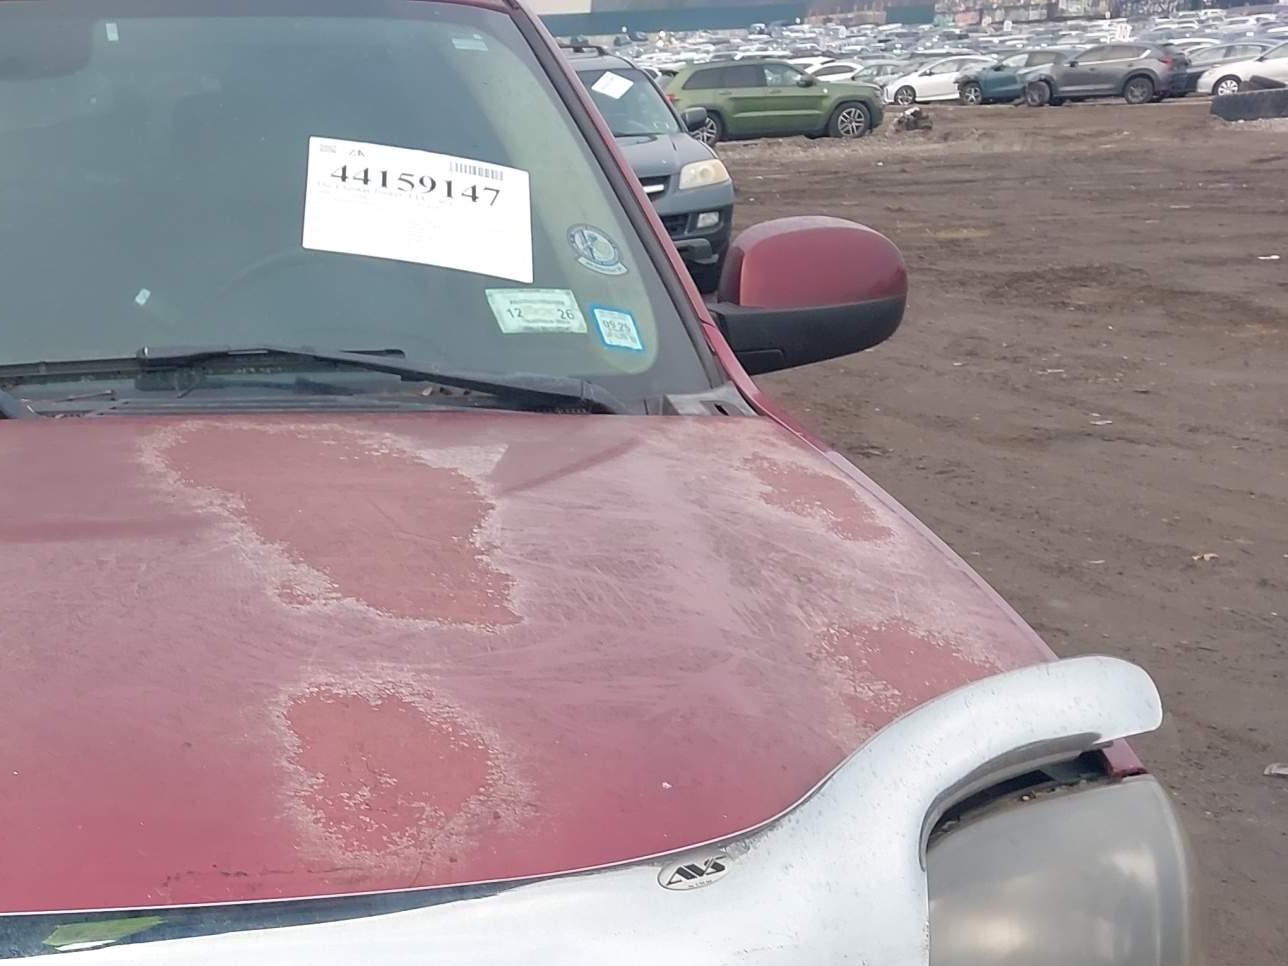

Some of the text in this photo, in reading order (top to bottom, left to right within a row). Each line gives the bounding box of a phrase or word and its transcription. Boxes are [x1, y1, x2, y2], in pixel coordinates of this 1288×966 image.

[330, 164, 501, 207] 44159147
[506, 308, 576, 321] 12 26
